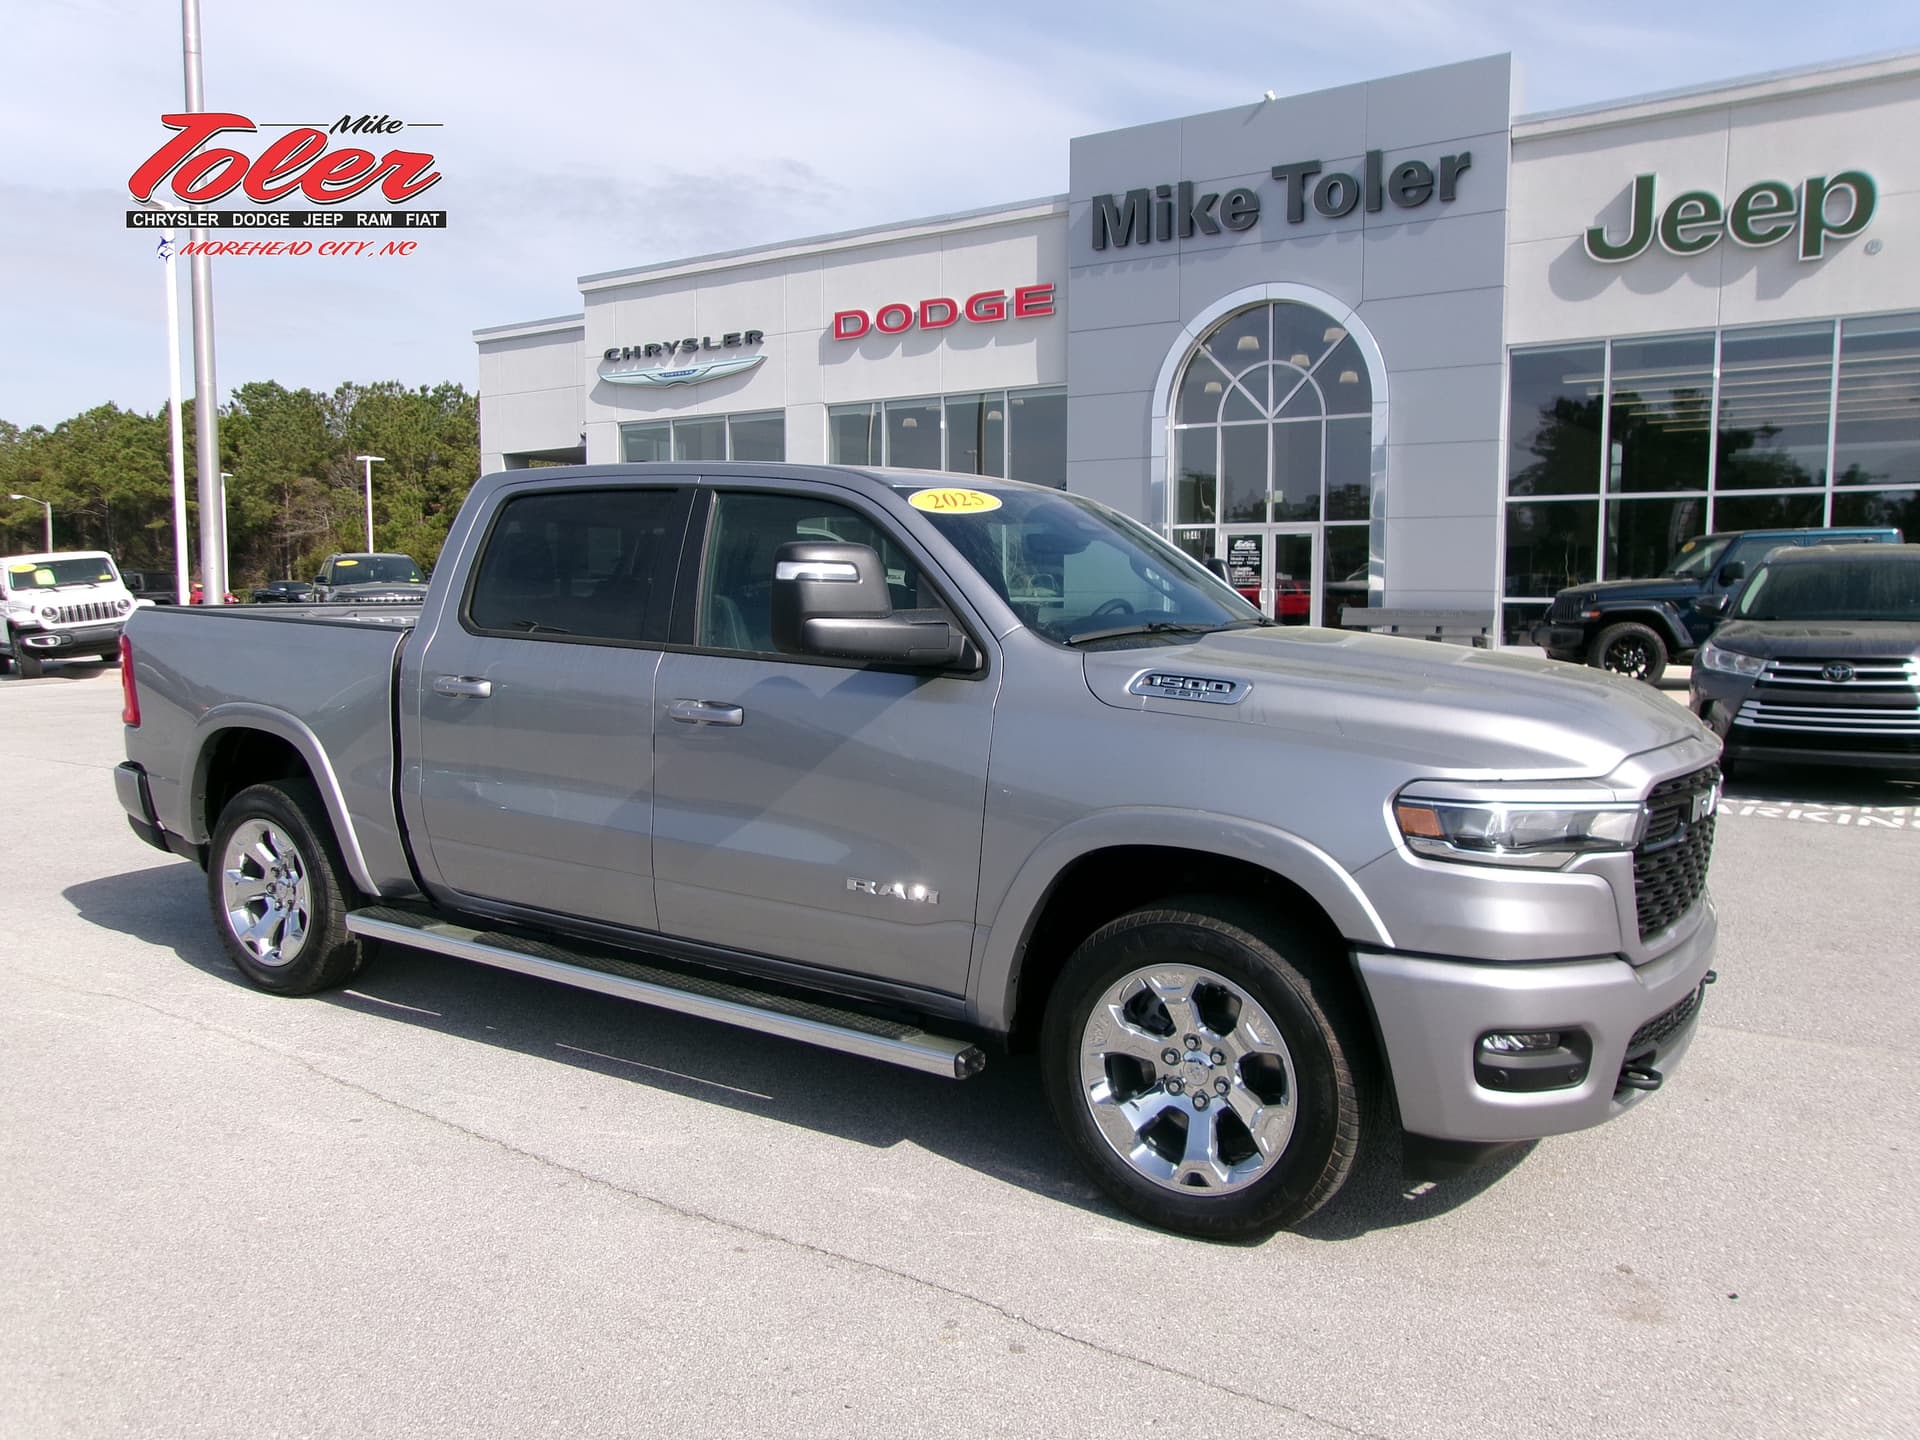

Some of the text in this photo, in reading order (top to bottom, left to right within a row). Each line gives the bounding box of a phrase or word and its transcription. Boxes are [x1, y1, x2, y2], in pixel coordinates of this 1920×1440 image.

[1091, 149, 1472, 251] Mike Toler
[1584, 170, 1879, 263] Jeep
[833, 282, 1056, 341] DODGE
[603, 329, 765, 362] CHRYSLER
[928, 492, 984, 509] 2025
[1150, 674, 1231, 693] 1500
[846, 878, 939, 904] RAM
